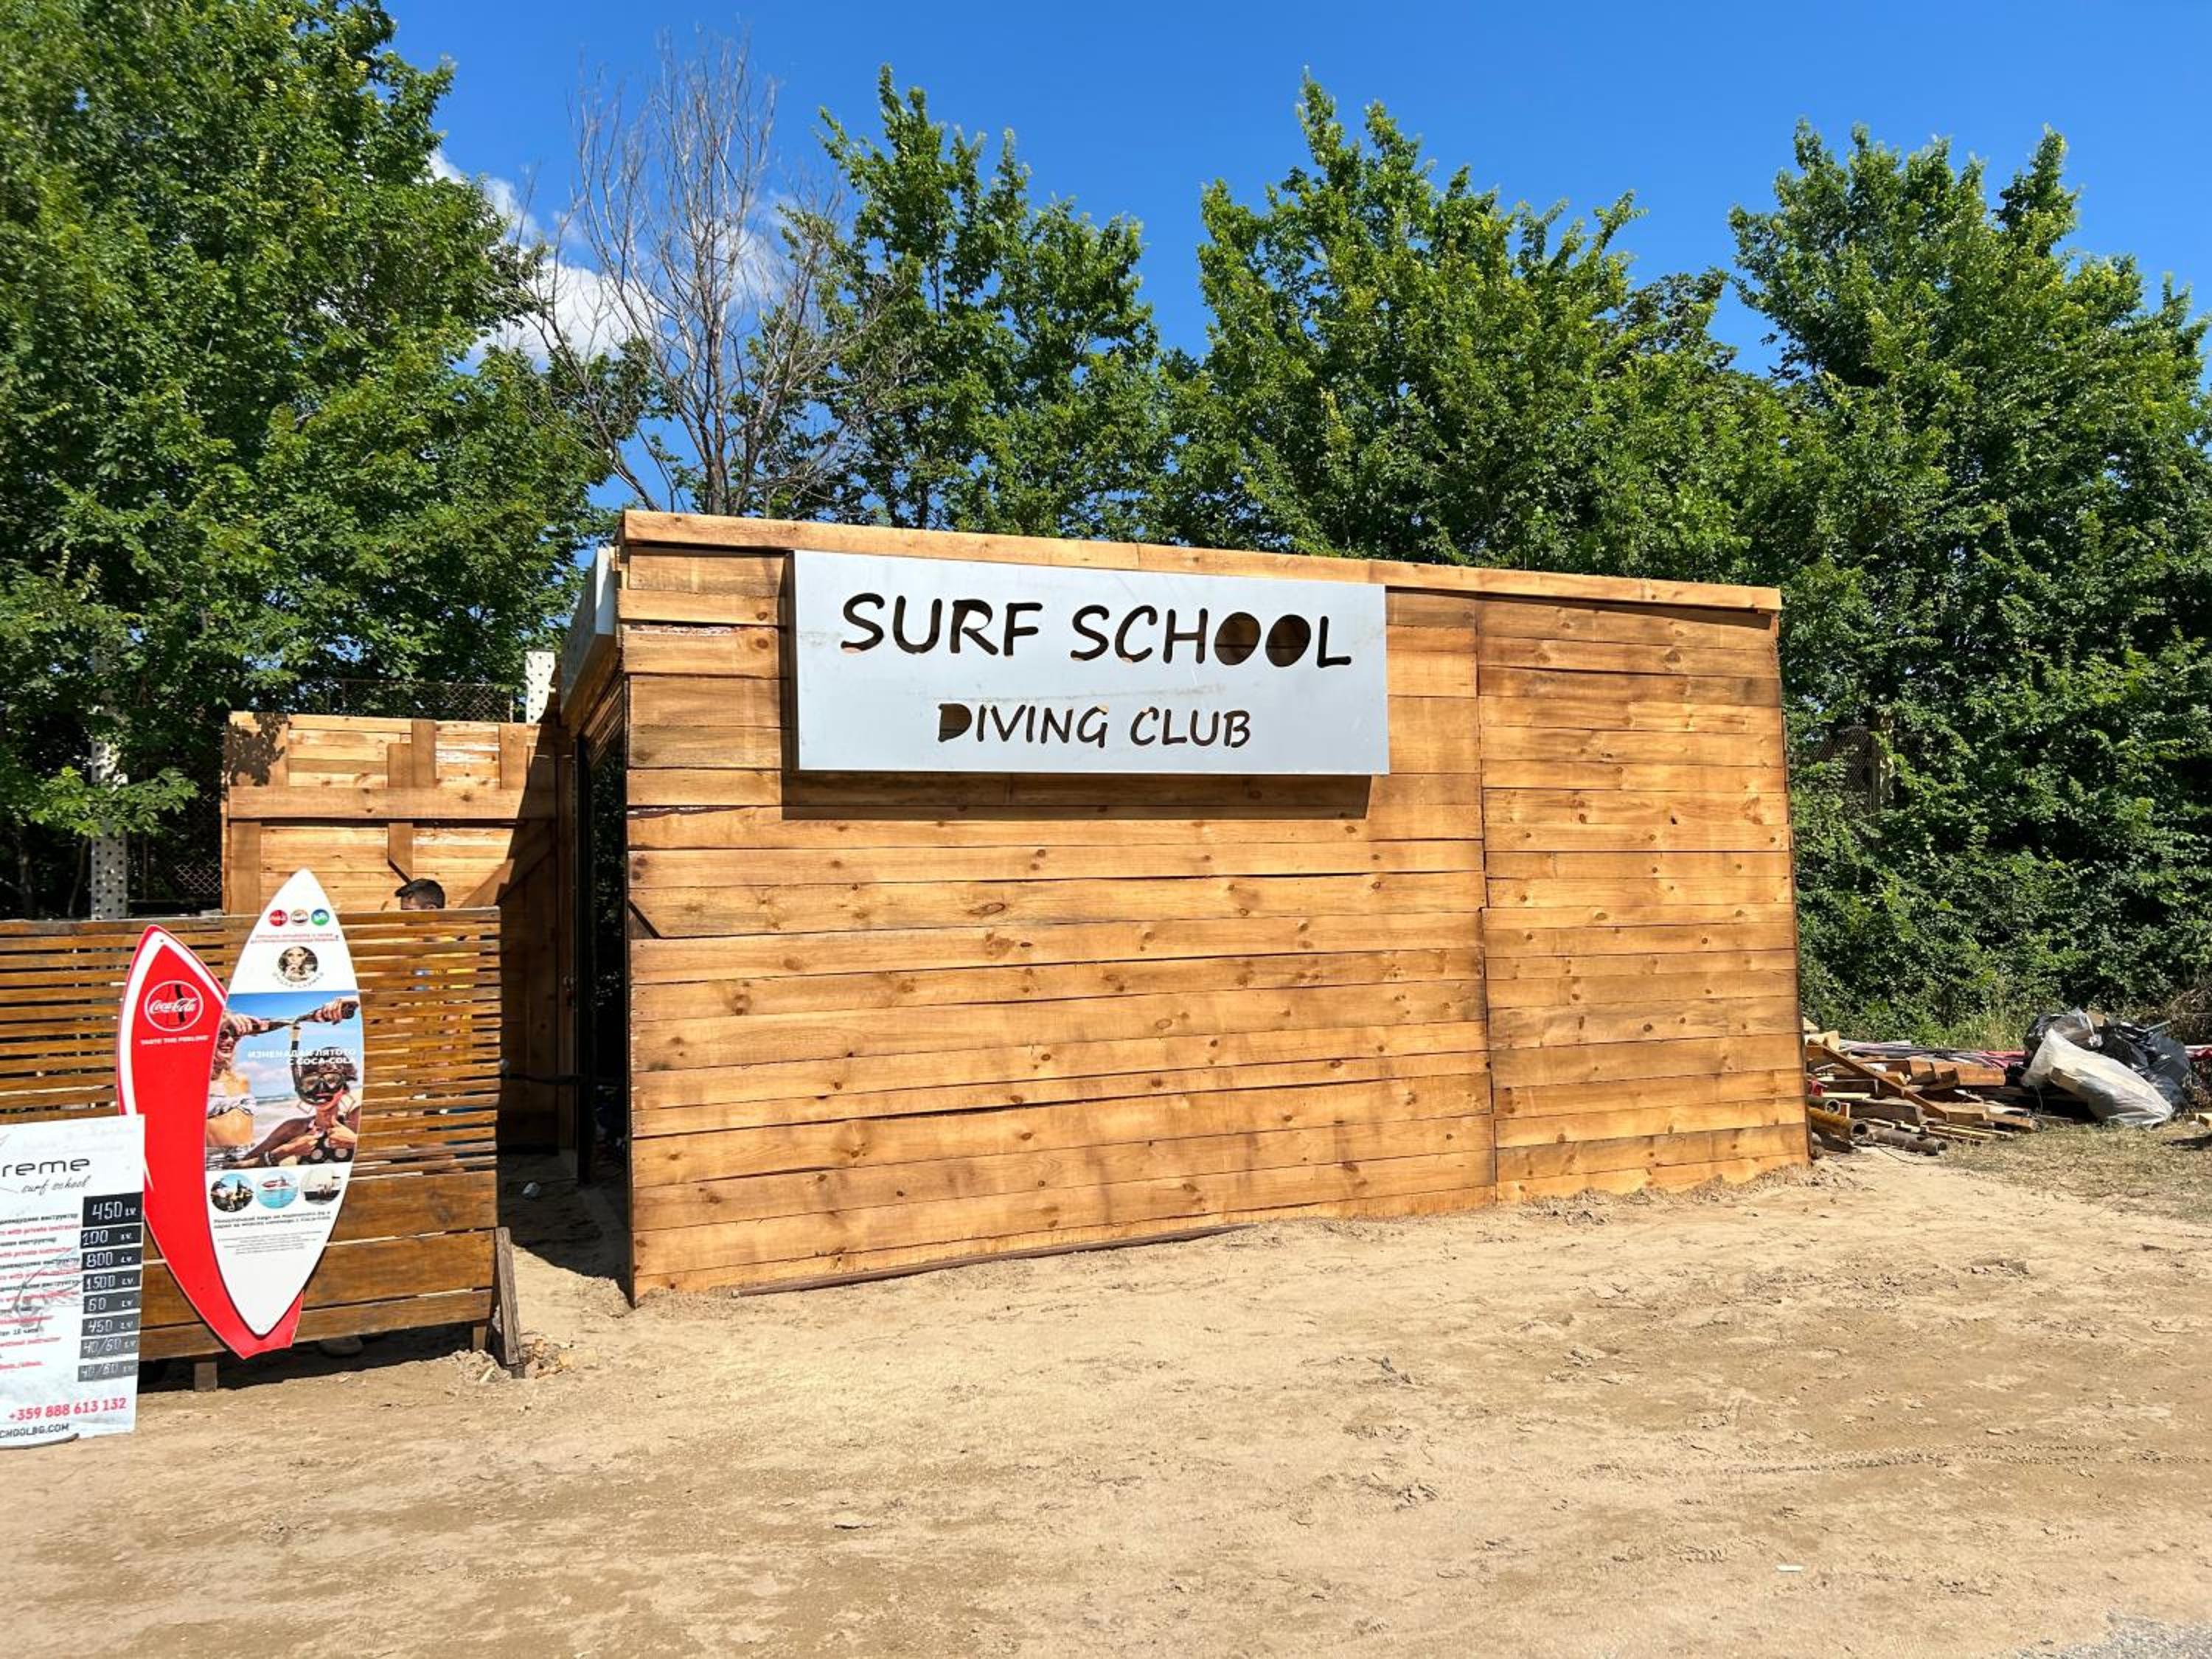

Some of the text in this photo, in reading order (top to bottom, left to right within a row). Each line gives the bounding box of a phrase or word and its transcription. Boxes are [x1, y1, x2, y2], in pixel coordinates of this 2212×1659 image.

[840, 592, 1352, 669] SURF SCHOOL
[937, 702, 1252, 749] DIVING CLUB
[296, 1057, 357, 1065] COCA-COLA
[92, 1201, 123, 1220] 450
[83, 1229, 108, 1247] 100
[9, 1397, 127, 1421] +359 888 613 132
